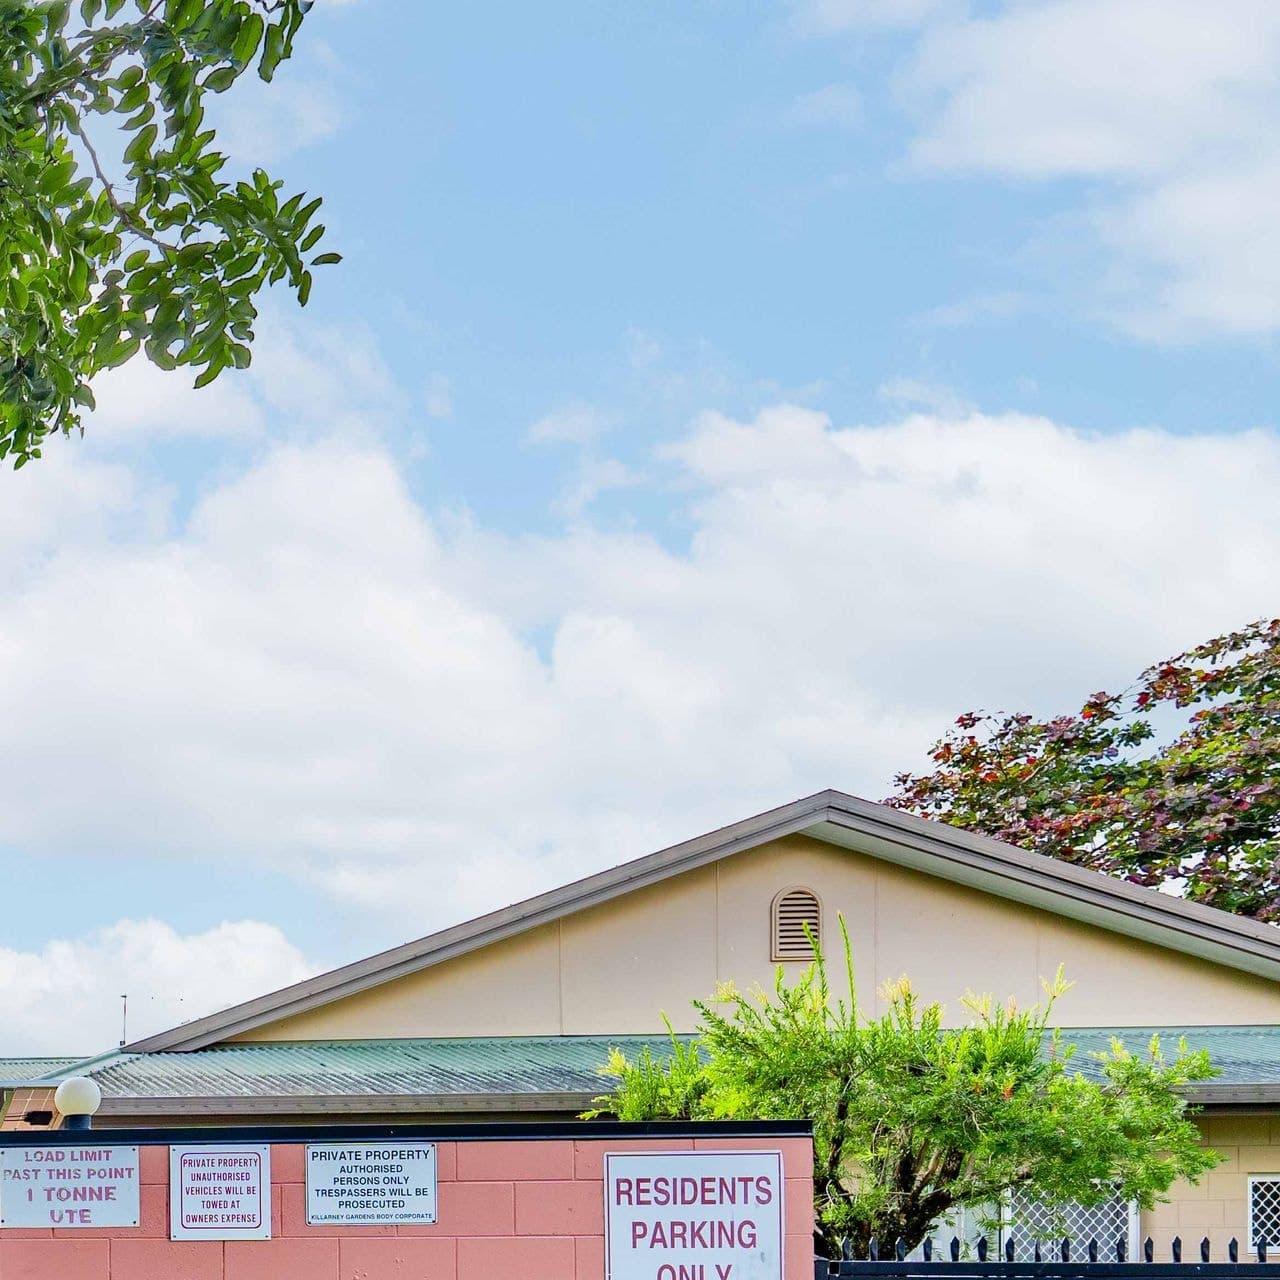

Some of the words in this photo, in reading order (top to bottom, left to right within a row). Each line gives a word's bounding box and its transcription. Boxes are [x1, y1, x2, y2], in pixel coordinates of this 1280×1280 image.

[25, 1150, 65, 1162] LOAD
[70, 1150, 112, 1161] LIMIT
[312, 1151, 361, 1161] PRIVATE
[366, 1150, 430, 1160] PROPERTY
[183, 1159, 215, 1167] PRIVATE
[218, 1158, 258, 1167] PROPERTY
[3, 1169, 41, 1180] PAST
[46, 1168, 81, 1180] THIS
[87, 1167, 135, 1179] POINT
[340, 1165, 403, 1174] AUTHORISED
[191, 1172, 251, 1181] UNAUTHORISED
[333, 1177, 380, 1185] PERSONS
[383, 1176, 410, 1185] ONLY
[27, 1188, 33, 1201] 1
[43, 1186, 117, 1201] TONNE
[185, 1187, 222, 1195] VEHICLES
[225, 1186, 243, 1195] WILL
[246, 1186, 256, 1195] BE
[315, 1188, 386, 1197] TRESPASSERS
[389, 1188, 412, 1196] WILL
[415, 1188, 428, 1196] BE
[616, 1176, 772, 1206] RESIDENTS
[202, 1200, 228, 1209] TOWED
[231, 1200, 240, 1209] AT
[339, 1200, 405, 1209] PROSECUTED
[50, 1209, 91, 1223] UTE
[186, 1214, 218, 1223] OWNERS
[221, 1214, 256, 1222] EXPENSE
[632, 1220, 757, 1249] PARKING
